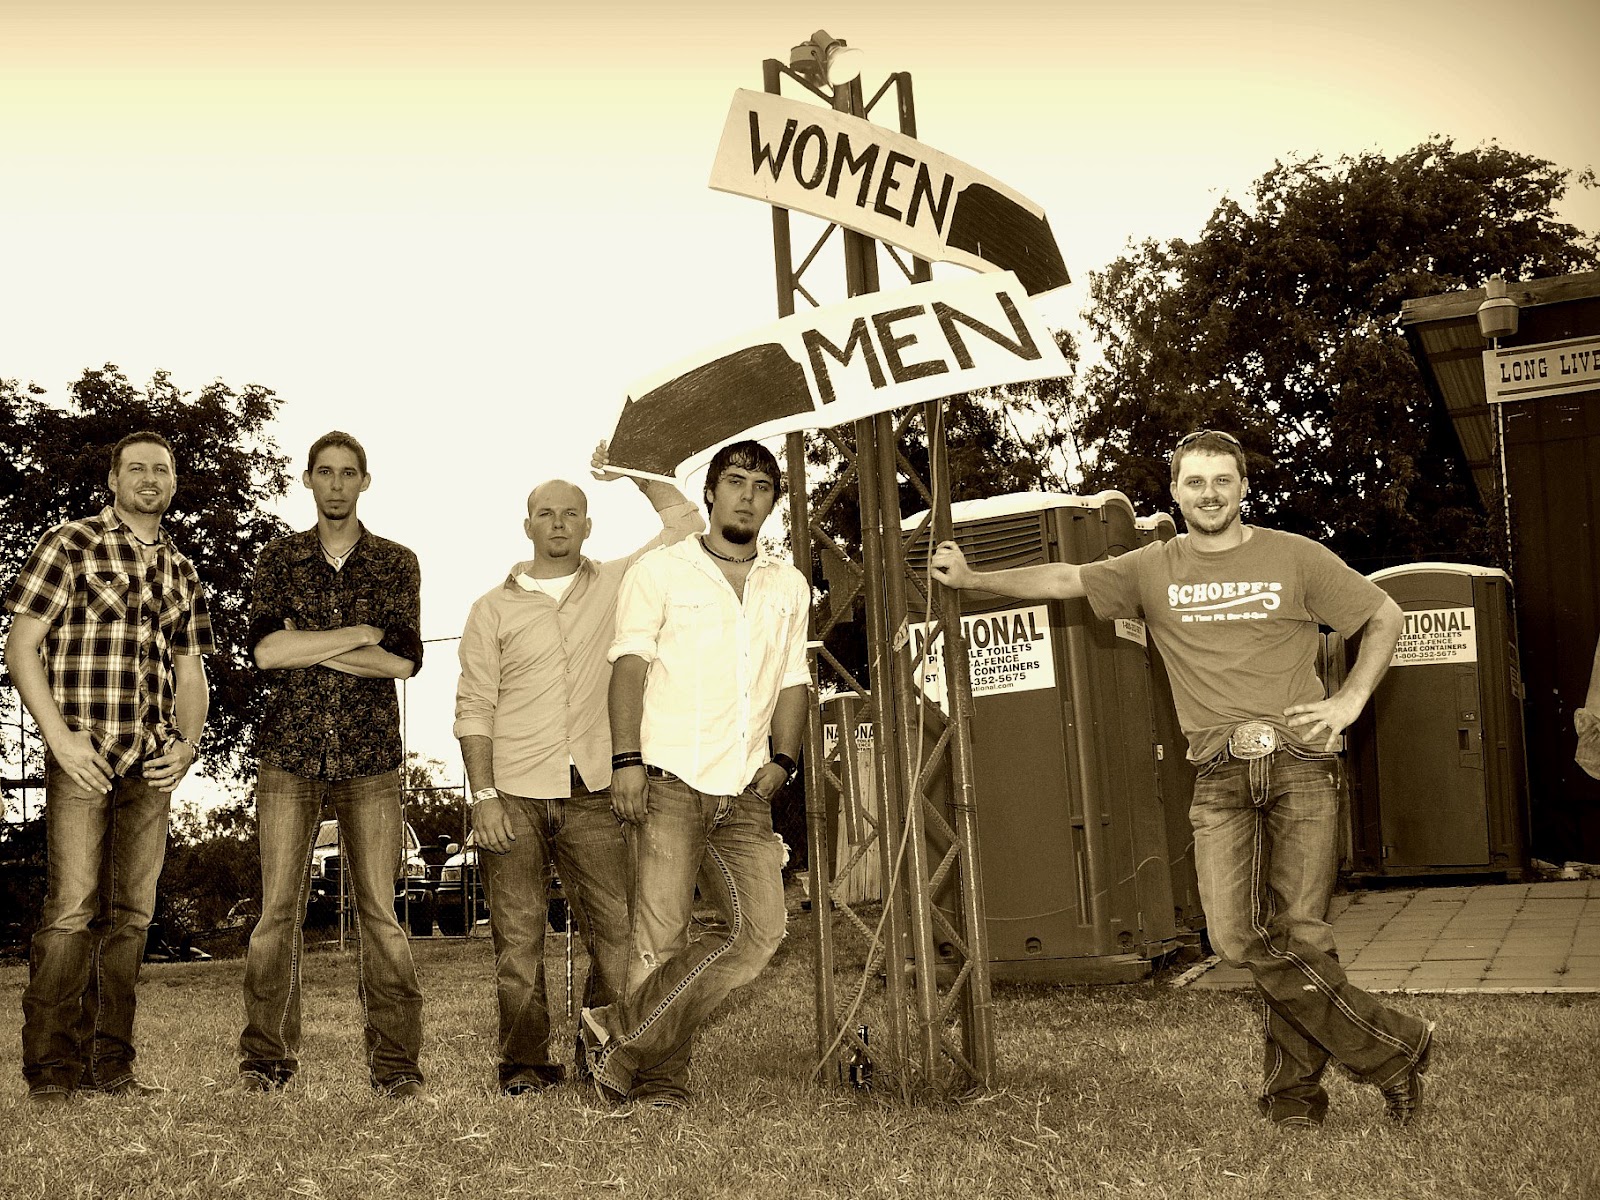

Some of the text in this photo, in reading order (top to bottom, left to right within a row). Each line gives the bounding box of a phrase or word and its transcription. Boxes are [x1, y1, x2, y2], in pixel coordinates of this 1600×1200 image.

[749, 110, 954, 237] WOMEN
[801, 291, 1043, 405] MEN
[1500, 349, 1600, 383] LONG LIVE
[1168, 581, 1283, 607] SCHOEPF'S
[1402, 611, 1471, 634] TIONAL
[986, 643, 1032, 656] TOILETS
[1397, 638, 1453, 647] RENT-A-FENCE
[1419, 643, 1467, 652] CONTAINERS
[970, 654, 1019, 668] -A-FENCE
[1395, 650, 1457, 660] 1-800-352-5675
[974, 661, 1040, 676] CONTAINERS
[971, 672, 1026, 686] -352-5675
